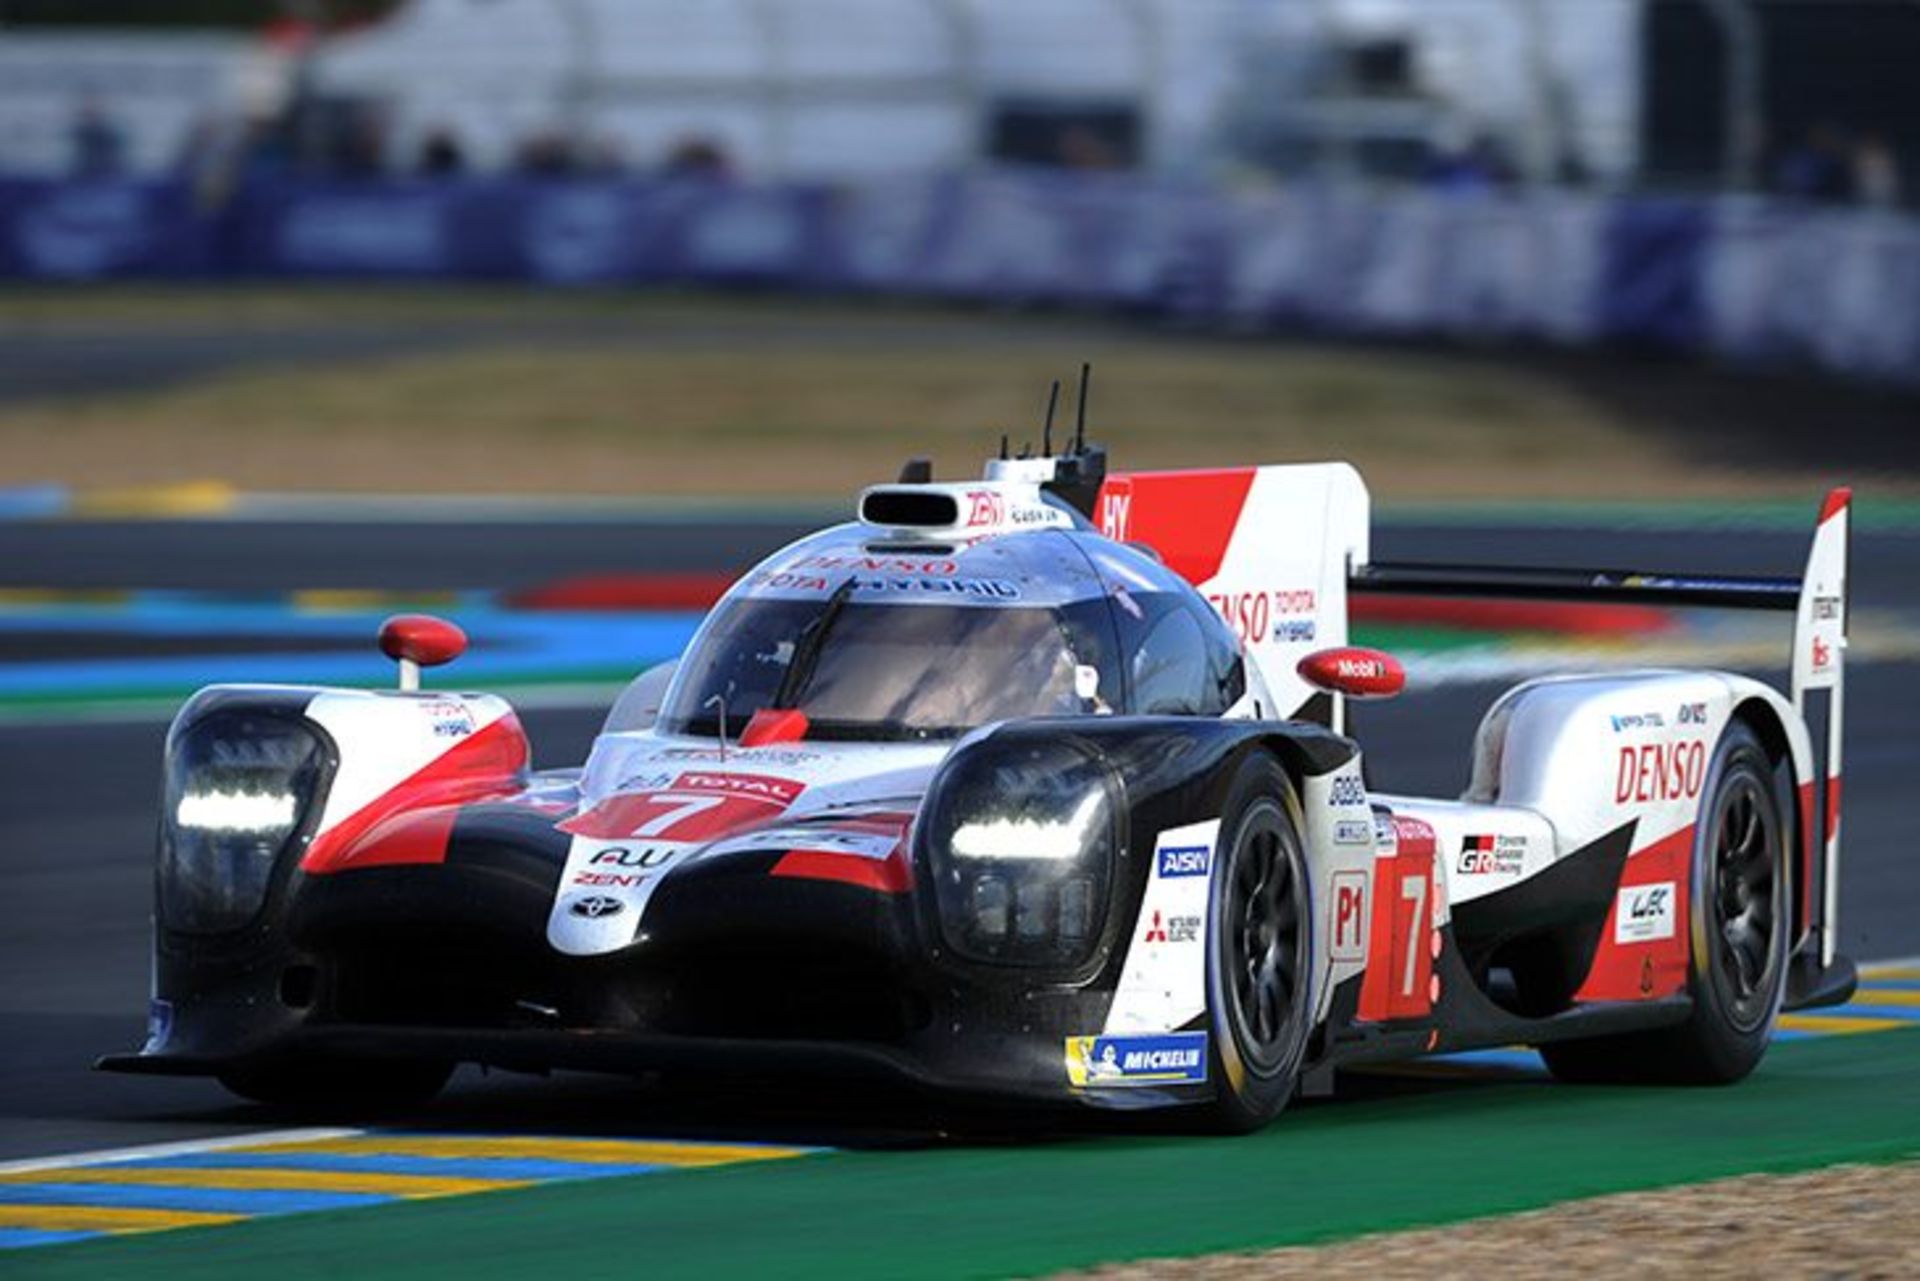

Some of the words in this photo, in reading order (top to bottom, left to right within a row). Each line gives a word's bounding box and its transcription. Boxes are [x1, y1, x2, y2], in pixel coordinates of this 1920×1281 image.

[1338, 659, 1374, 677] Mobil
[1615, 740, 1705, 804] DENSO
[684, 775, 792, 799] TOTAL
[629, 795, 728, 837] 7
[1460, 850, 1496, 873] GR
[573, 871, 652, 887] ZENT
[1335, 886, 1363, 947] P1
[1403, 876, 1427, 996] 7
[1124, 1048, 1200, 1069] MICHELIN
